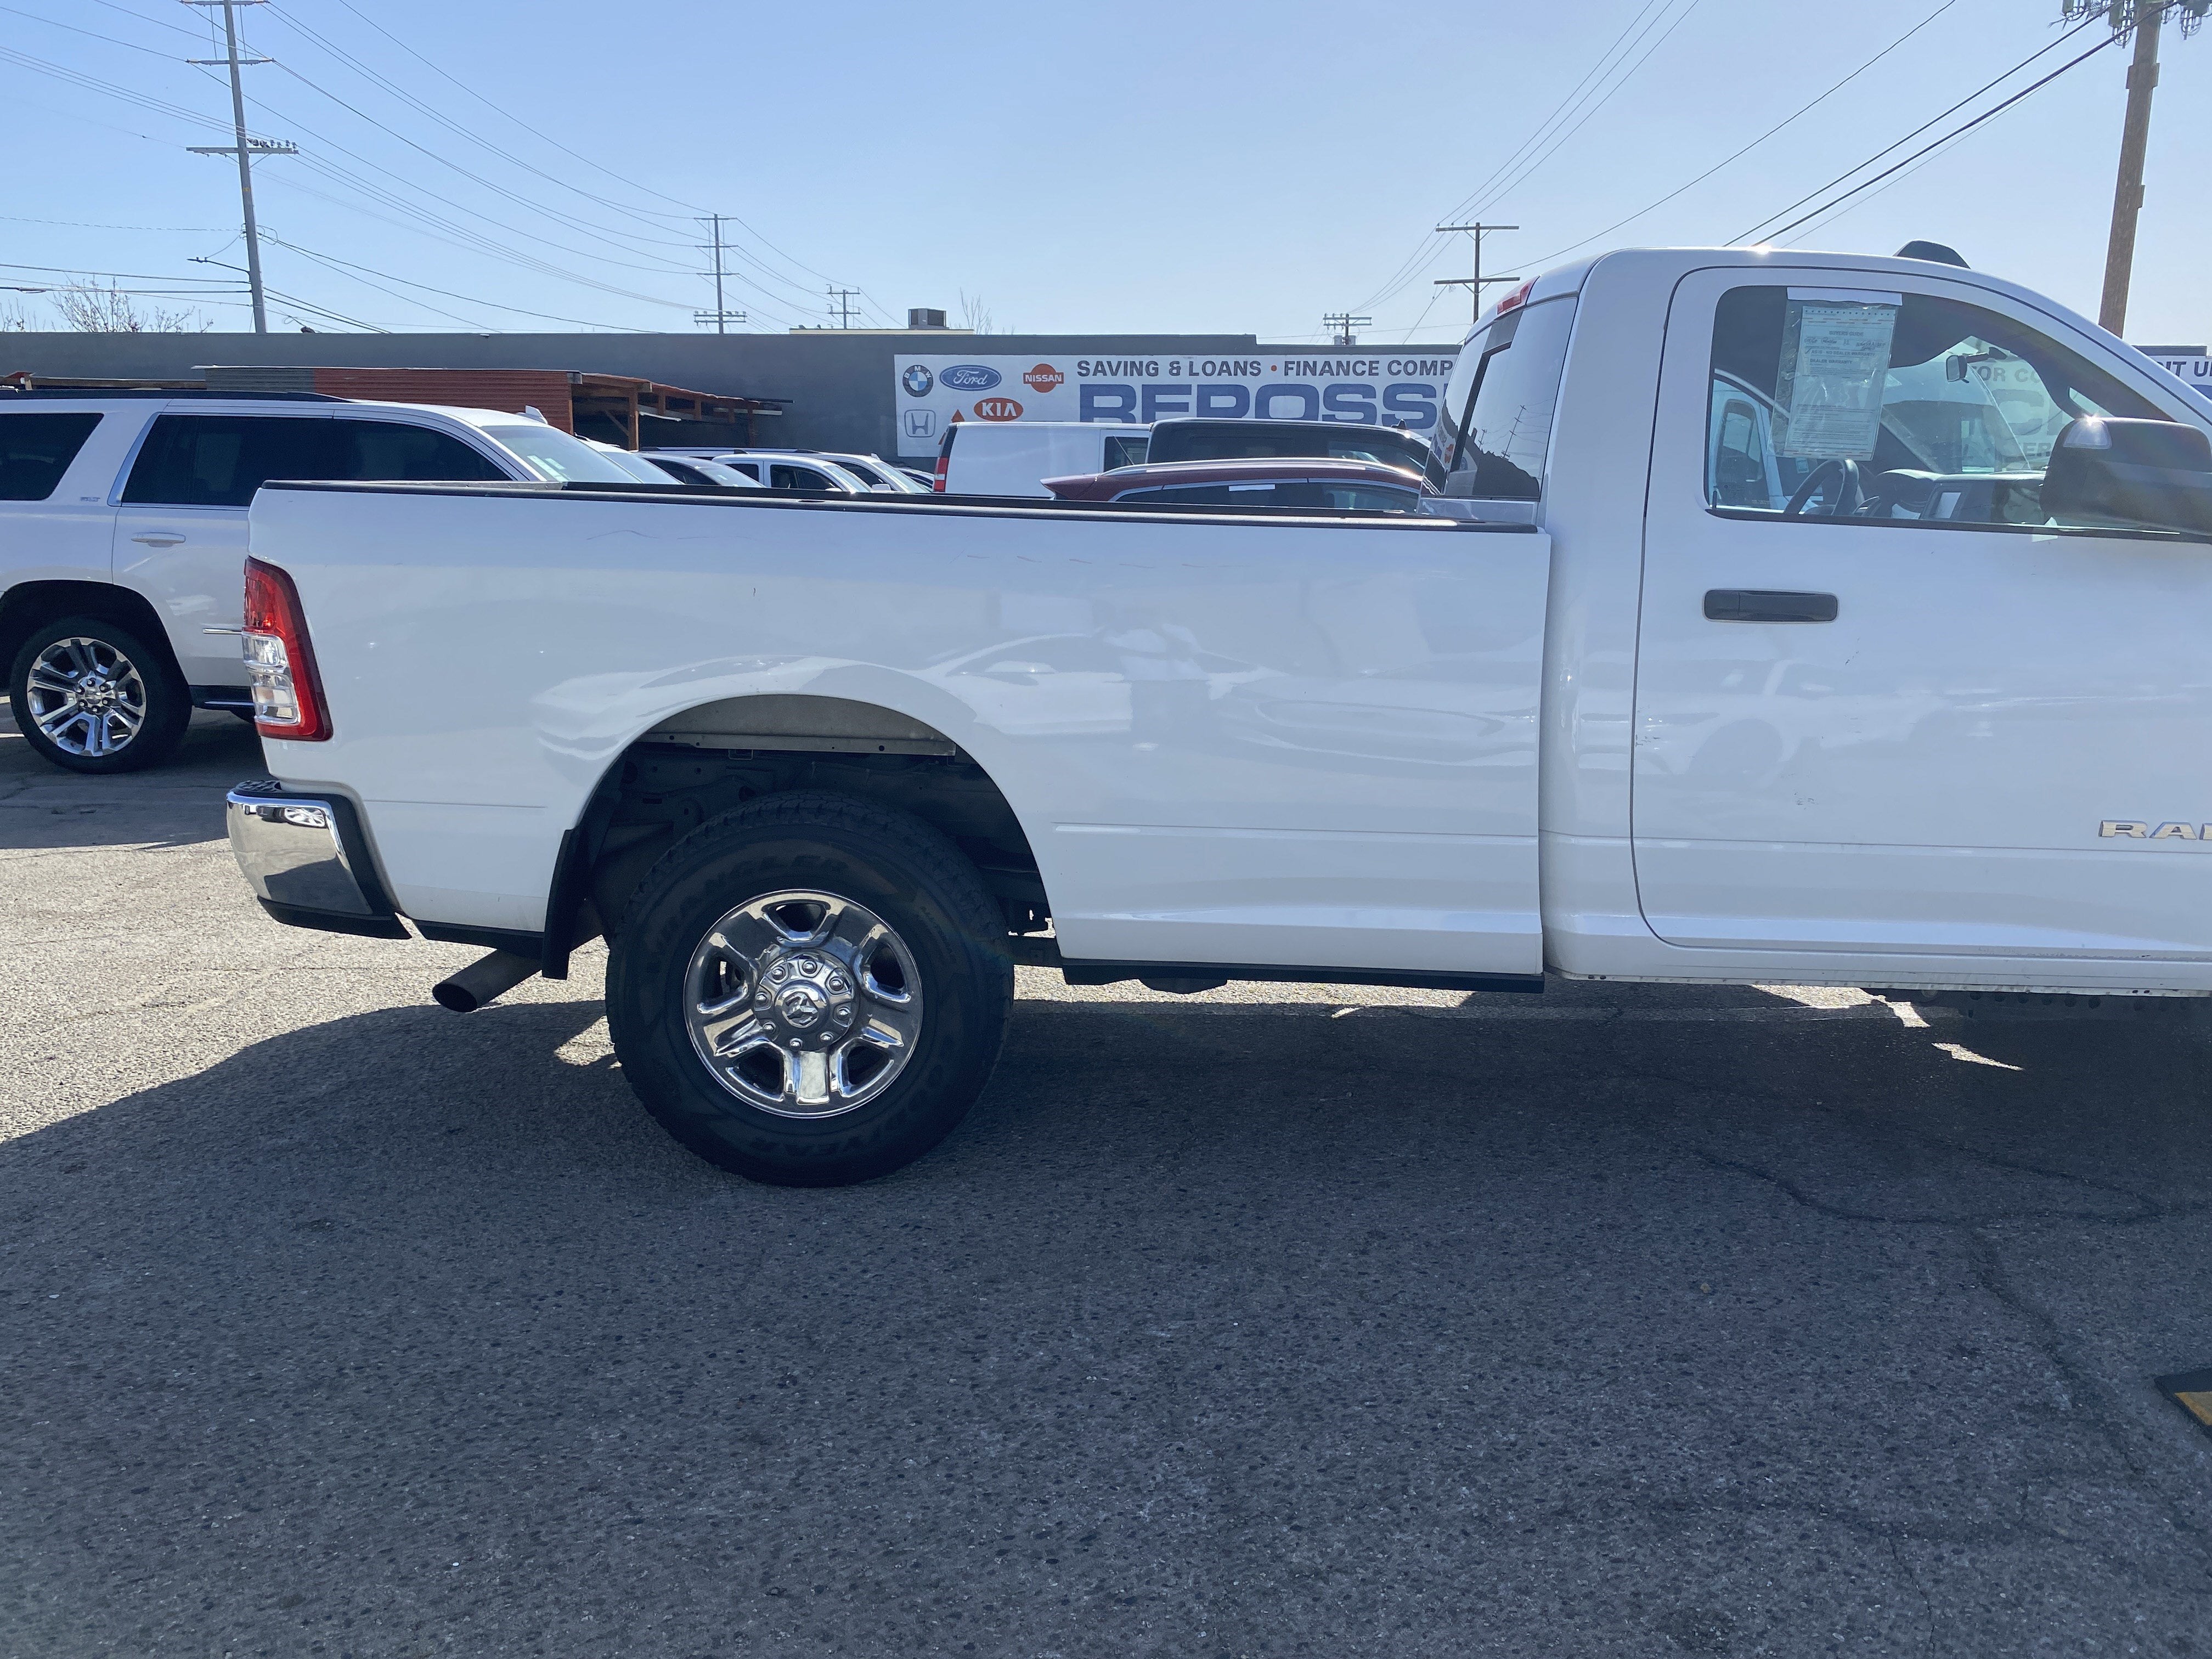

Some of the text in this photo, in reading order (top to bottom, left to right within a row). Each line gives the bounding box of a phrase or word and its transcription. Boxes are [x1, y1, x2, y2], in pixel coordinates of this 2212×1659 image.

[903, 365, 932, 379] BMW
[1077, 360, 1159, 377] SAVING
[1169, 360, 1182, 376] &
[1188, 360, 1262, 377] LOANS
[1284, 360, 1380, 376] FINANCE
[1972, 365, 2006, 382] OR
[2157, 361, 2212, 377] IT U
[953, 370, 988, 385] Ford
[1025, 374, 1062, 382] NISSAN
[981, 402, 1017, 417] KIA
[1079, 383, 1448, 430] REPOSS
[2098, 820, 2212, 840] RA
